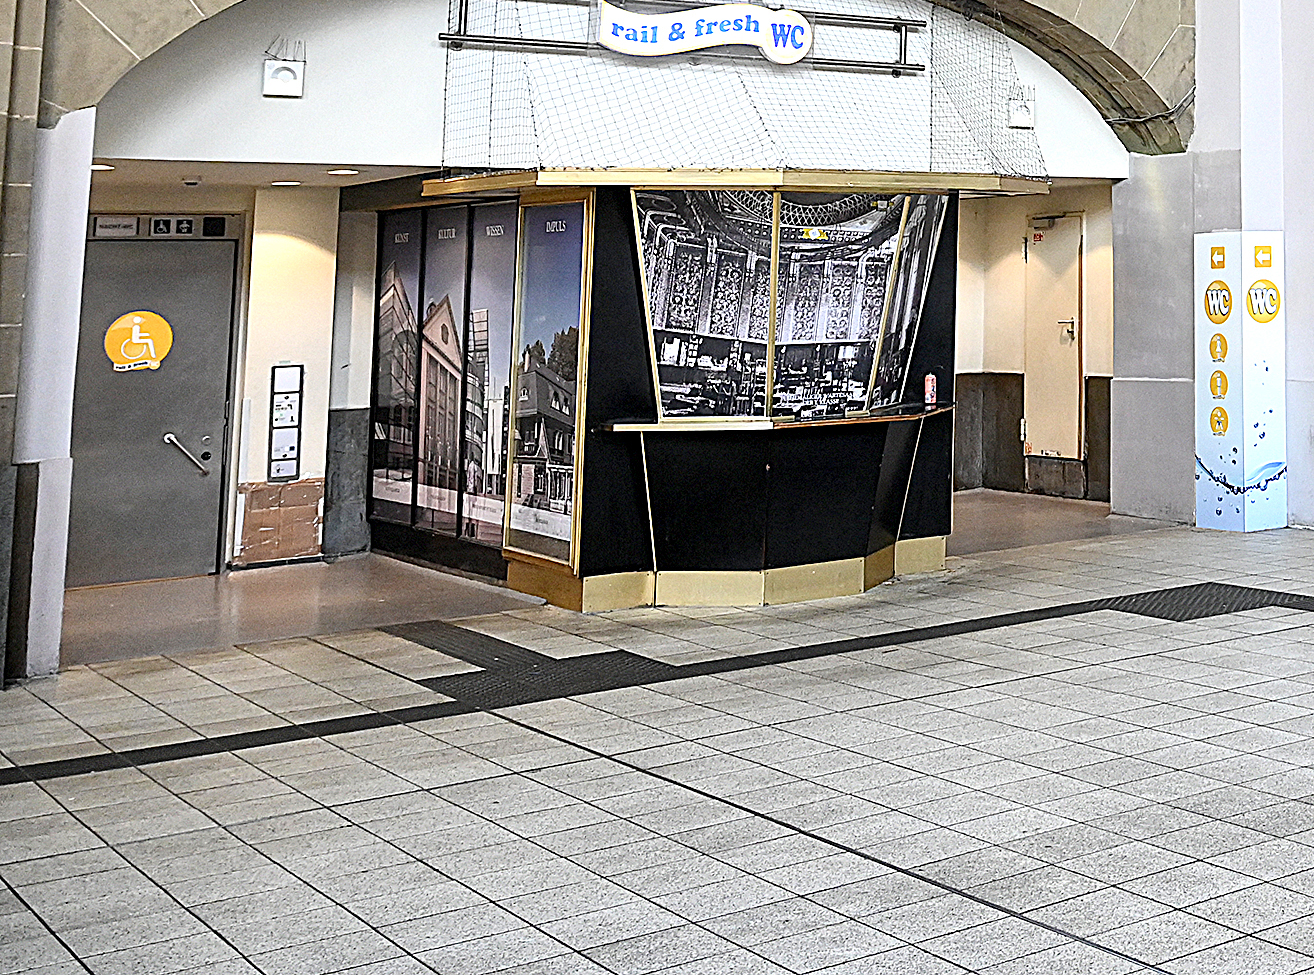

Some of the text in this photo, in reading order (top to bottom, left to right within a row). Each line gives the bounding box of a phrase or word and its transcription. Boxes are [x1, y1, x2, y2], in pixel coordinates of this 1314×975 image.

[611, 14, 805, 50] rail & fresh WC
[485, 224, 505, 237] WISSEN
[1206, 289, 1229, 316] WC
[1249, 288, 1277, 315] WC
